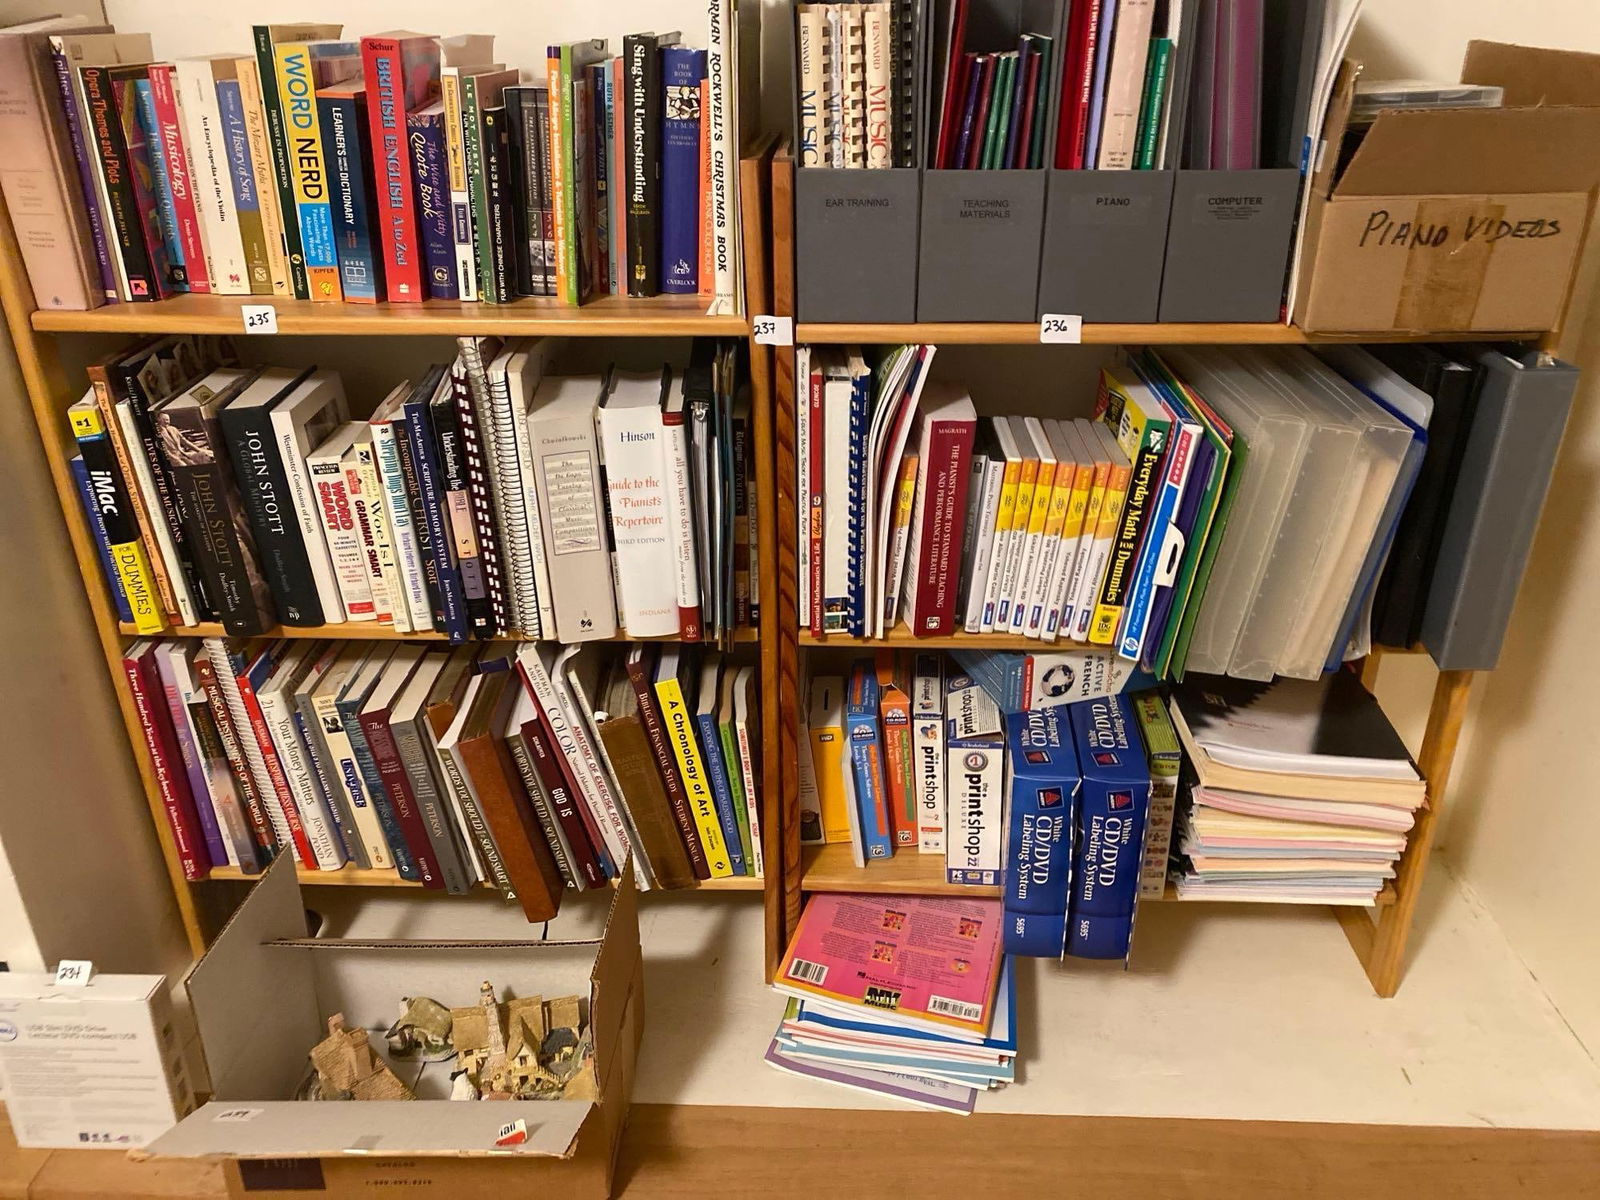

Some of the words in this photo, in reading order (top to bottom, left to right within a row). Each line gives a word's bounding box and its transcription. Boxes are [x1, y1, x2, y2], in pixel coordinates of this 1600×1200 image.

[369, 43, 394, 51] Schur
[631, 45, 645, 78] Sing
[284, 54, 313, 129] WORD
[376, 57, 396, 128] BRITISH
[466, 84, 473, 98] LE
[634, 78, 645, 105] with
[710, 52, 723, 142] ROCKWELL'S
[86, 69, 99, 98] Opera
[93, 100, 109, 138] Themes
[107, 160, 119, 184] Plots
[469, 106, 477, 130] MOT
[801, 90, 818, 165] MUSIC
[870, 85, 888, 160] MUSIC
[163, 121, 187, 199] Musicology
[295, 138, 323, 199] NERD
[332, 107, 347, 156] LEARNER'S
[340, 172, 354, 224] DICTIONARY
[383, 134, 405, 209] ENGLISH
[471, 136, 480, 175] JUSTE
[633, 109, 647, 203] Understanding
[410, 132, 427, 180] Quote
[420, 183, 436, 220] Book
[714, 150, 726, 228] CHRISTMAS
[826, 199, 844, 207] EAR
[847, 199, 889, 207] TRAINING
[960, 210, 1010, 218] MATERIALS
[963, 200, 1009, 208] TEACHING
[1096, 198, 1130, 206] PIANO
[1208, 197, 1263, 206] COMPUTER
[391, 215, 404, 225] A
[493, 204, 502, 244] CHARACTERS
[1359, 210, 1448, 248] PIANO
[1464, 215, 1561, 244] VIDEOS
[395, 242, 407, 265] Zed
[496, 246, 504, 271] CHINESE
[717, 236, 727, 272] BOOK
[499, 272, 507, 288] WITH
[249, 312, 269, 326] 235
[754, 323, 775, 335] 237
[1044, 321, 1068, 333] 236
[76, 417, 92, 427] #1
[620, 432, 655, 442] Hinson
[442, 432, 457, 478] Understanding
[450, 479, 462, 490] the
[675, 457, 684, 468] all
[952, 445, 960, 459] THE
[91, 471, 118, 516] iMac
[144, 438, 156, 463] LIVES
[152, 464, 160, 475] OF
[156, 477, 168, 494] THE
[163, 496, 183, 543] MUSICIANS
[246, 431, 269, 476] JOHN
[259, 482, 285, 535] STOTT
[283, 434, 298, 472] Westminster
[293, 474, 306, 507] Confession
[305, 518, 314, 533] Faith
[634, 479, 643, 488] to
[645, 476, 660, 487] the
[674, 470, 684, 485] you
[939, 471, 947, 487] AND
[948, 461, 959, 494] PIANIST'S
[1135, 454, 1159, 506] Everyday
[318, 482, 340, 531] SMART
[331, 481, 354, 530] WORD
[620, 497, 662, 508] Pianist's
[677, 487, 687, 505] have
[680, 507, 686, 517] to
[945, 497, 954, 520] GUIDE
[193, 473, 217, 512] JOHN
[211, 520, 234, 566] STOTT
[371, 501, 385, 539] Woe
[380, 545, 390, 558] Is
[614, 516, 663, 528] Repertoire
[681, 518, 690, 531] do
[933, 489, 946, 541] PERFORMANCE
[944, 521, 952, 531] TO
[1122, 508, 1142, 540] Math
[355, 500, 374, 546] GRAMMAR
[367, 549, 382, 578] SMART
[682, 540, 691, 560] listen
[941, 533, 951, 568] STANDARD
[1120, 542, 1135, 550] FOR
[929, 543, 940, 584] LITERATURE
[1107, 550, 1133, 603] Dummies
[122, 554, 151, 615] DUMMIES
[936, 570, 948, 608] TEACHING
[534, 663, 552, 697] KAUFMAN
[1081, 655, 1093, 696] FRENCH
[1094, 656, 1105, 692] ACTIVE
[261, 699, 273, 709] 21
[668, 700, 679, 710] A
[548, 707, 576, 756] COLOR
[1091, 703, 1115, 748] CD/DVD
[206, 685, 224, 727] MUSICAL
[250, 799, 263, 825] WORLD
[278, 718, 292, 740] Your
[285, 740, 303, 772] Money
[297, 771, 315, 805] Matters
[673, 713, 700, 780] Chronology
[572, 725, 594, 760] ANATOMY
[590, 759, 599, 772] OF
[595, 771, 614, 808] EXERCISE
[609, 807, 620, 824] FOR
[639, 692, 655, 730] BIBLICAL
[650, 727, 669, 768] FINANCIAL
[663, 768, 678, 793] STUDY
[674, 799, 690, 833] STUDENT
[685, 832, 700, 864] MANUAL
[693, 783, 702, 797] of
[392, 783, 412, 818] PETERSON
[552, 787, 568, 804] GOD
[560, 808, 573, 817] IS
[697, 799, 711, 818] Art
[312, 817, 333, 858] JONATHAN
[425, 802, 444, 838] PETERSON
[1018, 814, 1035, 860] Labeling
[1052, 815, 1063, 842] White
[1122, 818, 1133, 845] White
[312, 837, 325, 860] POND
[1032, 815, 1053, 885] CD/DVD
[1085, 815, 1098, 865] Labeling
[1099, 816, 1122, 887] CD/DVD
[966, 856, 978, 867] 22
[1018, 861, 1032, 900] System
[1083, 866, 1095, 901] System
[61, 966, 81, 979] 234
